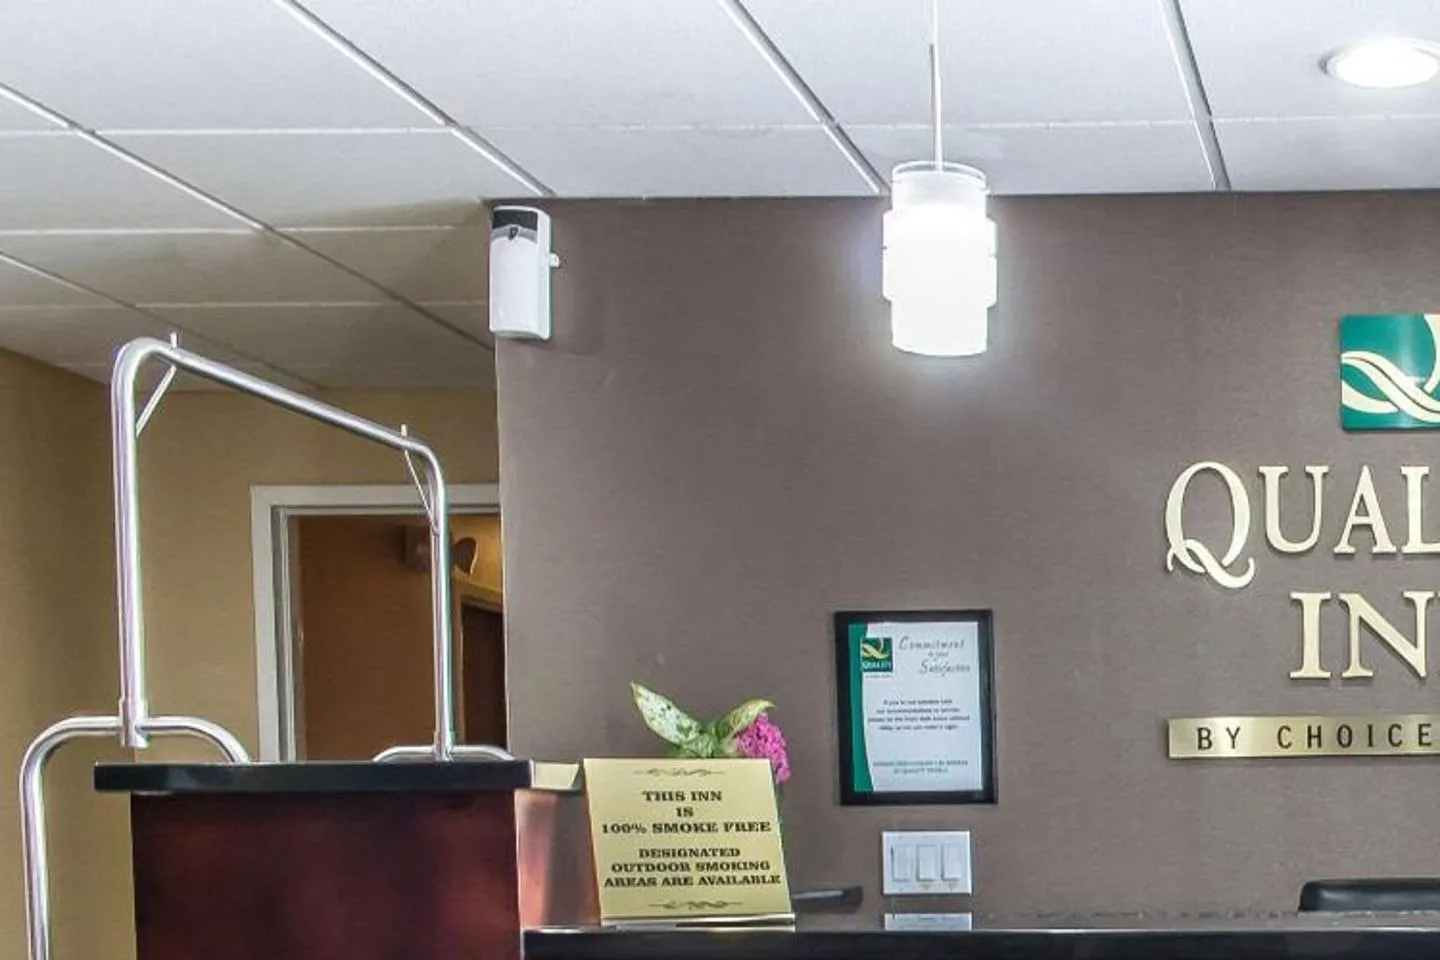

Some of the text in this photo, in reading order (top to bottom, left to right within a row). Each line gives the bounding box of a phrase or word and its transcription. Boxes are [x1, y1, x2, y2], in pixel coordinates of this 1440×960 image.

[1197, 726, 1241, 750] BY
[1277, 723, 1432, 749] CHOICE
[642, 790, 722, 802] THIS INN
[676, 807, 694, 818] IS
[602, 821, 772, 834] 100% SMOKE FREE
[638, 847, 741, 859] DESIGNATED
[611, 860, 770, 872] OUTDOOR SMOKING
[604, 875, 781, 887] AREAS ARE AVAILABLE
